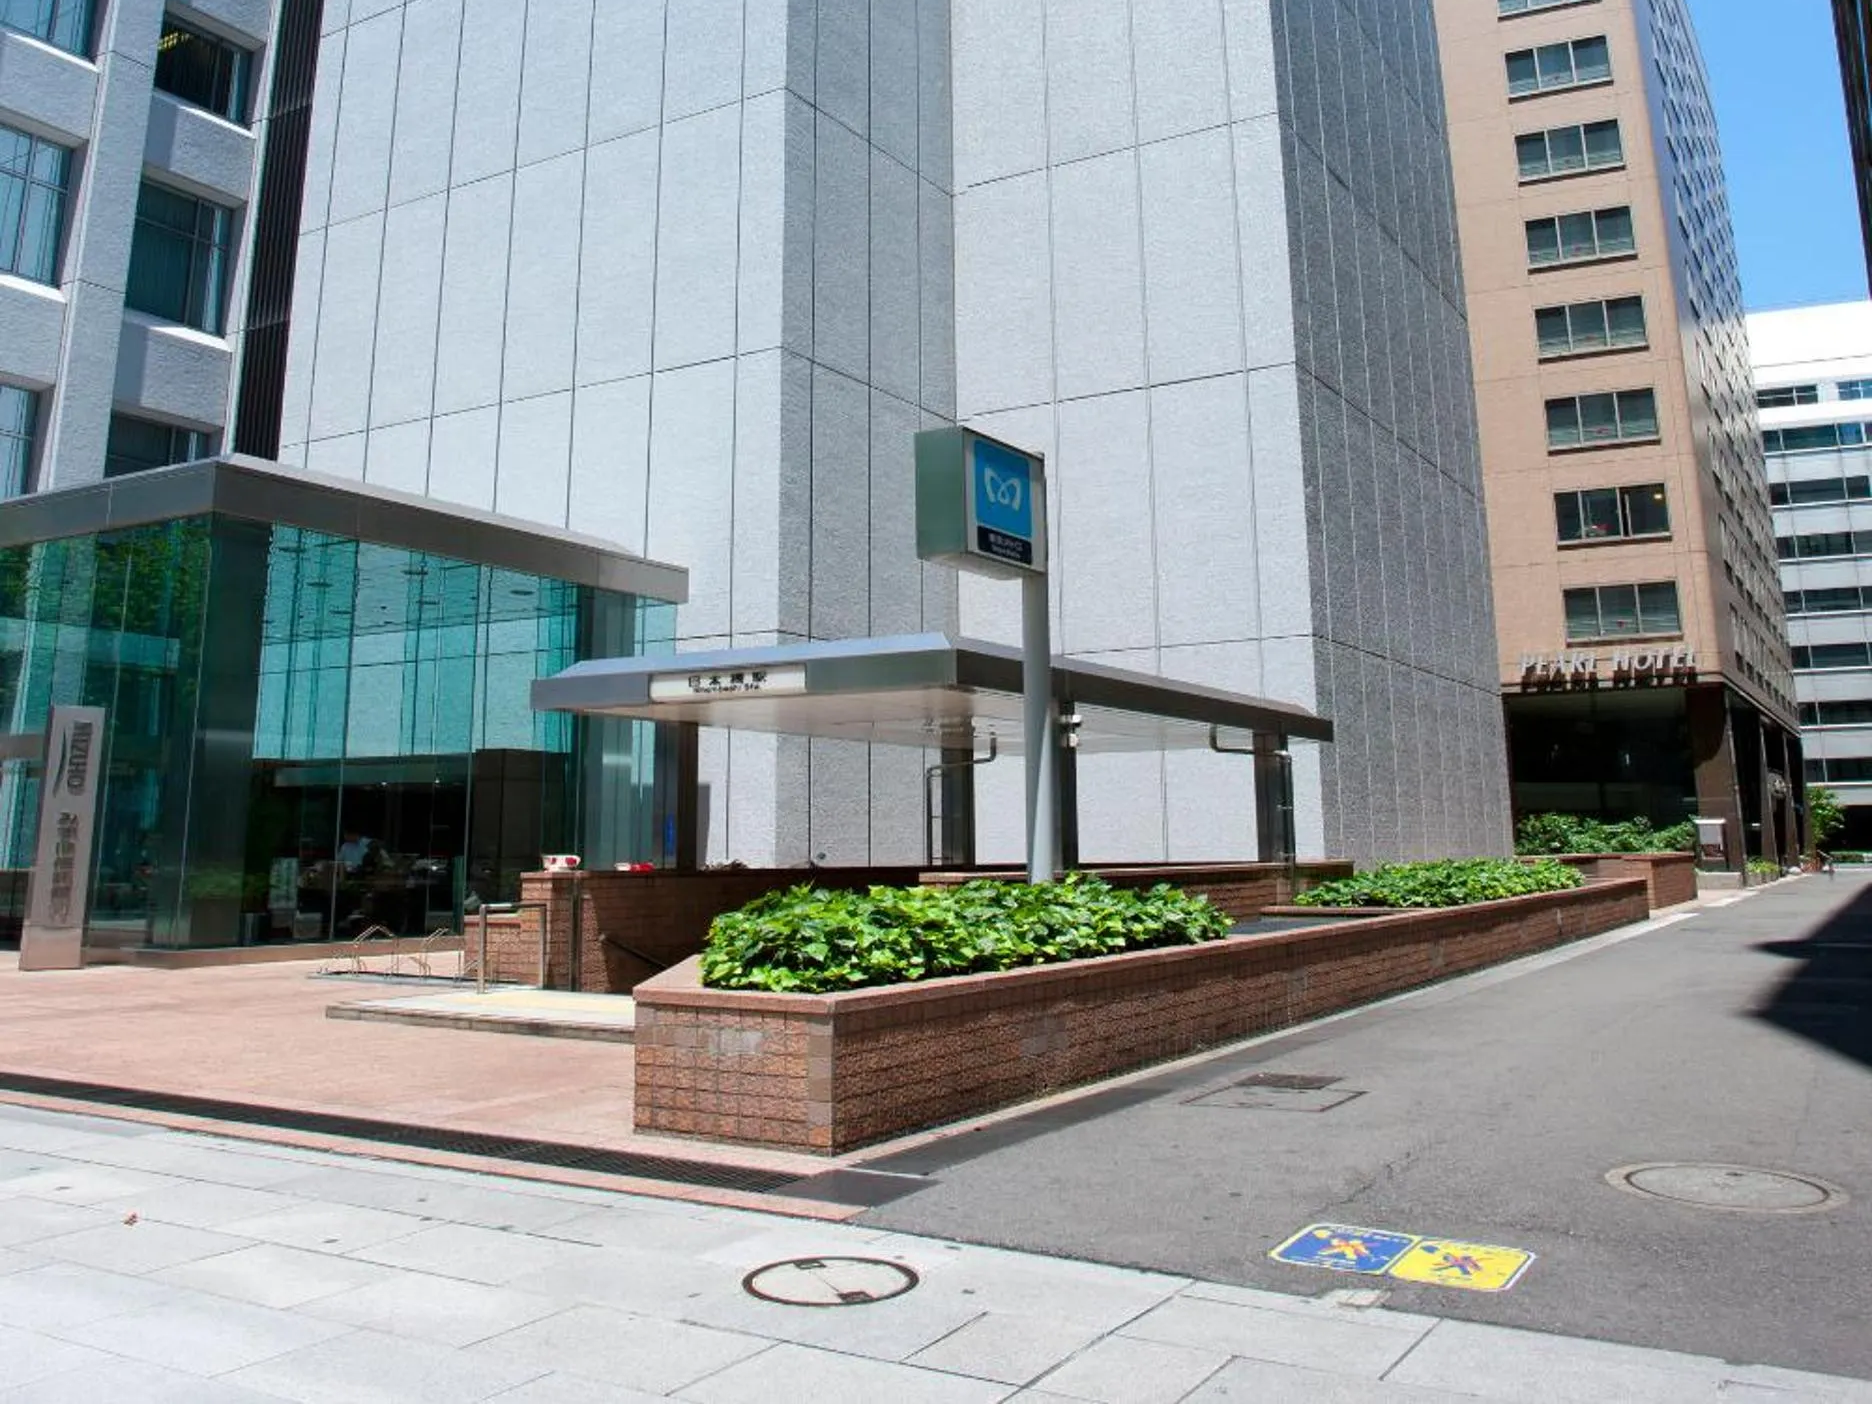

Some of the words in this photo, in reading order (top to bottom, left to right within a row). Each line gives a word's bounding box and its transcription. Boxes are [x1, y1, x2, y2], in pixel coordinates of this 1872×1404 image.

[1520, 652, 1597, 675] PEARL
[1613, 647, 1697, 671] HOTEL
[67, 720, 93, 795] MIZUHO
